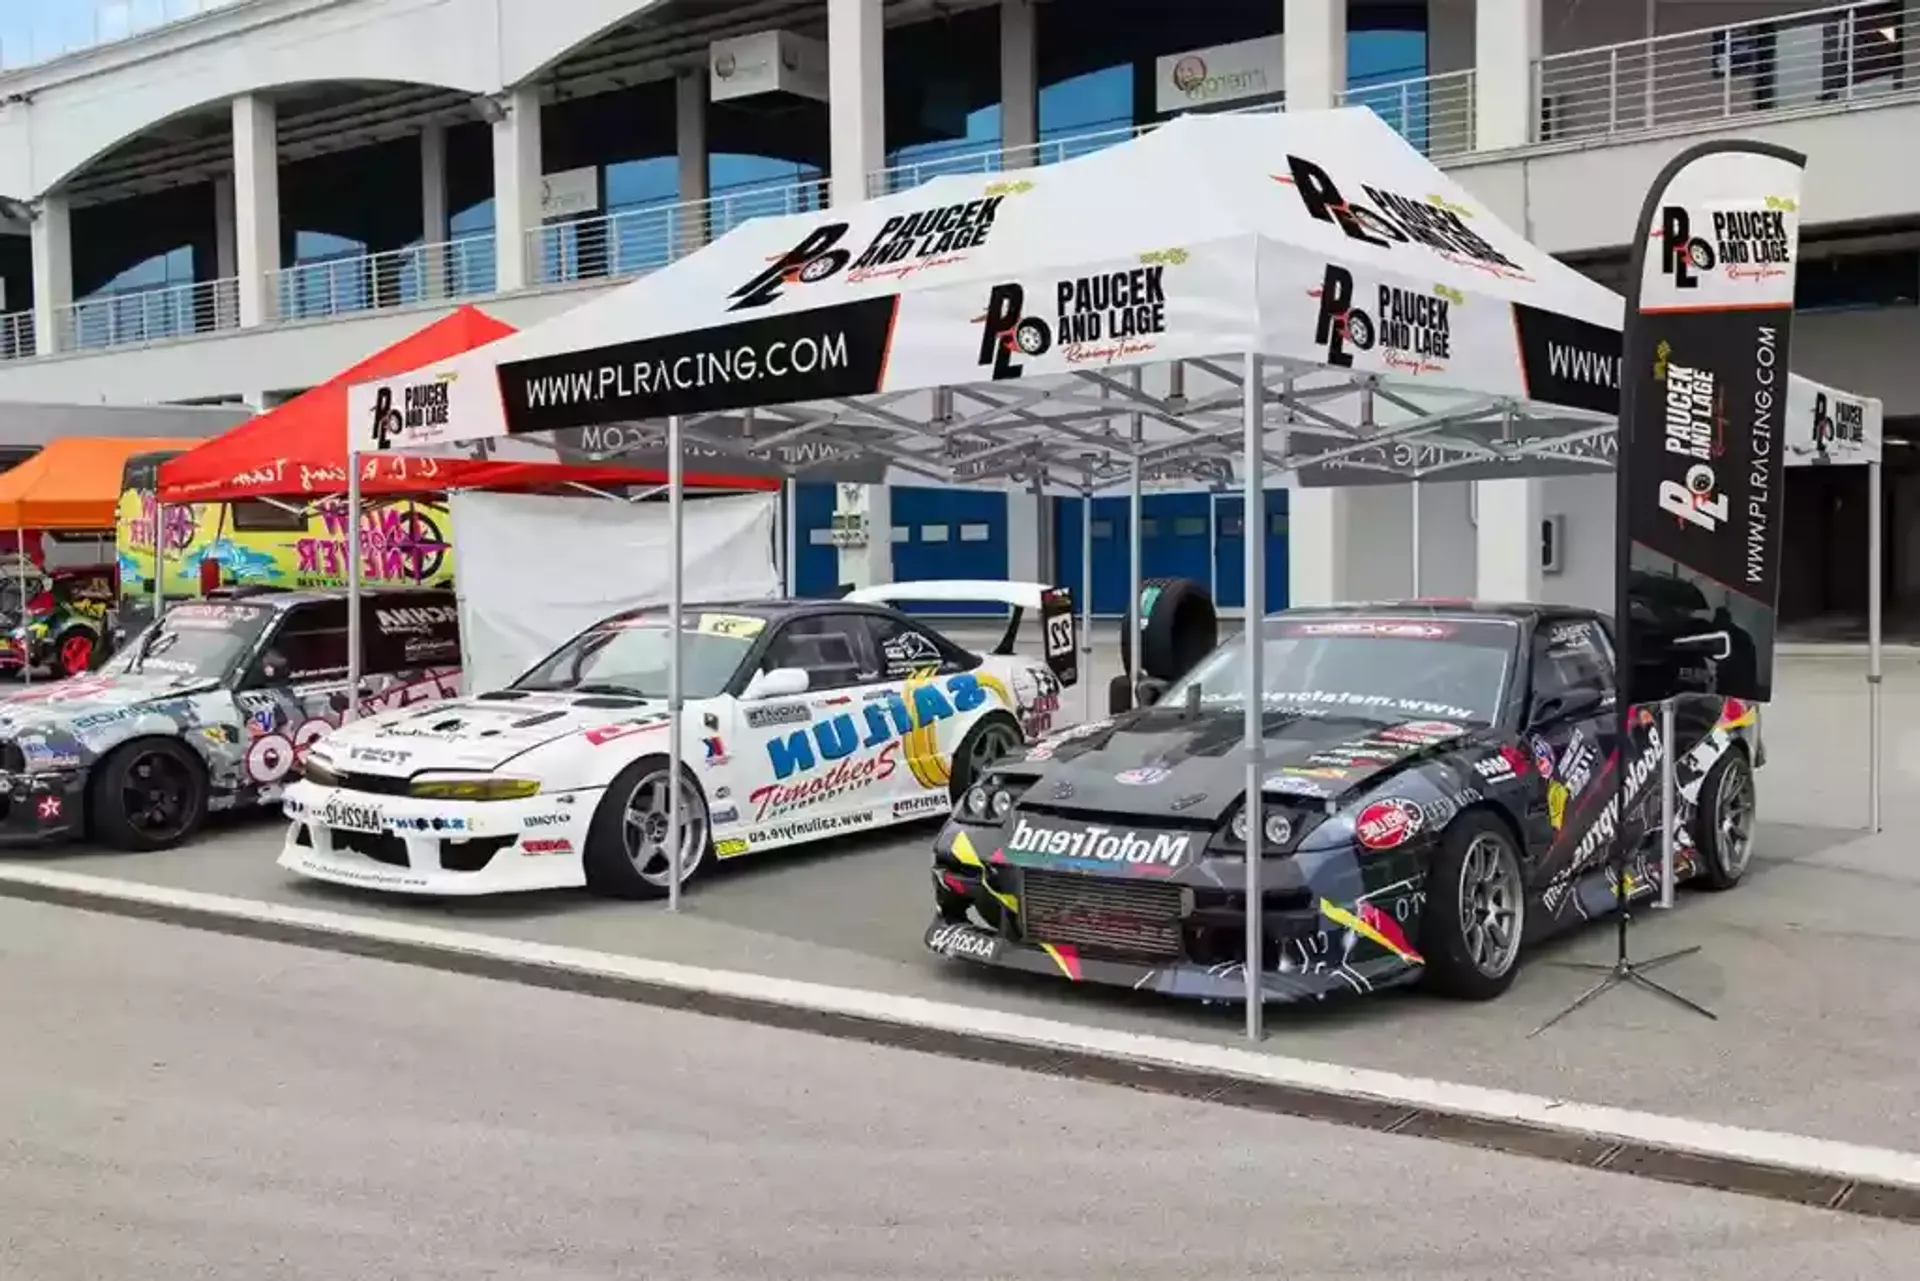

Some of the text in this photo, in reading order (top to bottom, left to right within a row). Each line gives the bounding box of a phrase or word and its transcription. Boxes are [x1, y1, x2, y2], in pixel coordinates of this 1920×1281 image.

[871, 194, 1005, 245] PAUCEK
[1712, 211, 1786, 241] PAUCEK
[849, 222, 992, 270] AND LAGE
[1719, 240, 1790, 264] AND LAGE
[1057, 266, 1164, 316] PAUCEK
[1379, 284, 1449, 332] PAUCEK
[1057, 304, 1165, 345] AND LAGE
[1379, 319, 1450, 360] AND LAGE
[526, 331, 849, 408] WWW.PLRACING.COM
[405, 381, 449, 409] PAUCEK
[426, 404, 449, 426] LAGE
[1665, 361, 1694, 455] PAUCEK
[1690, 368, 1715, 461] AND LAGE
[1746, 326, 1777, 583] WWW.PLRACING.COM
